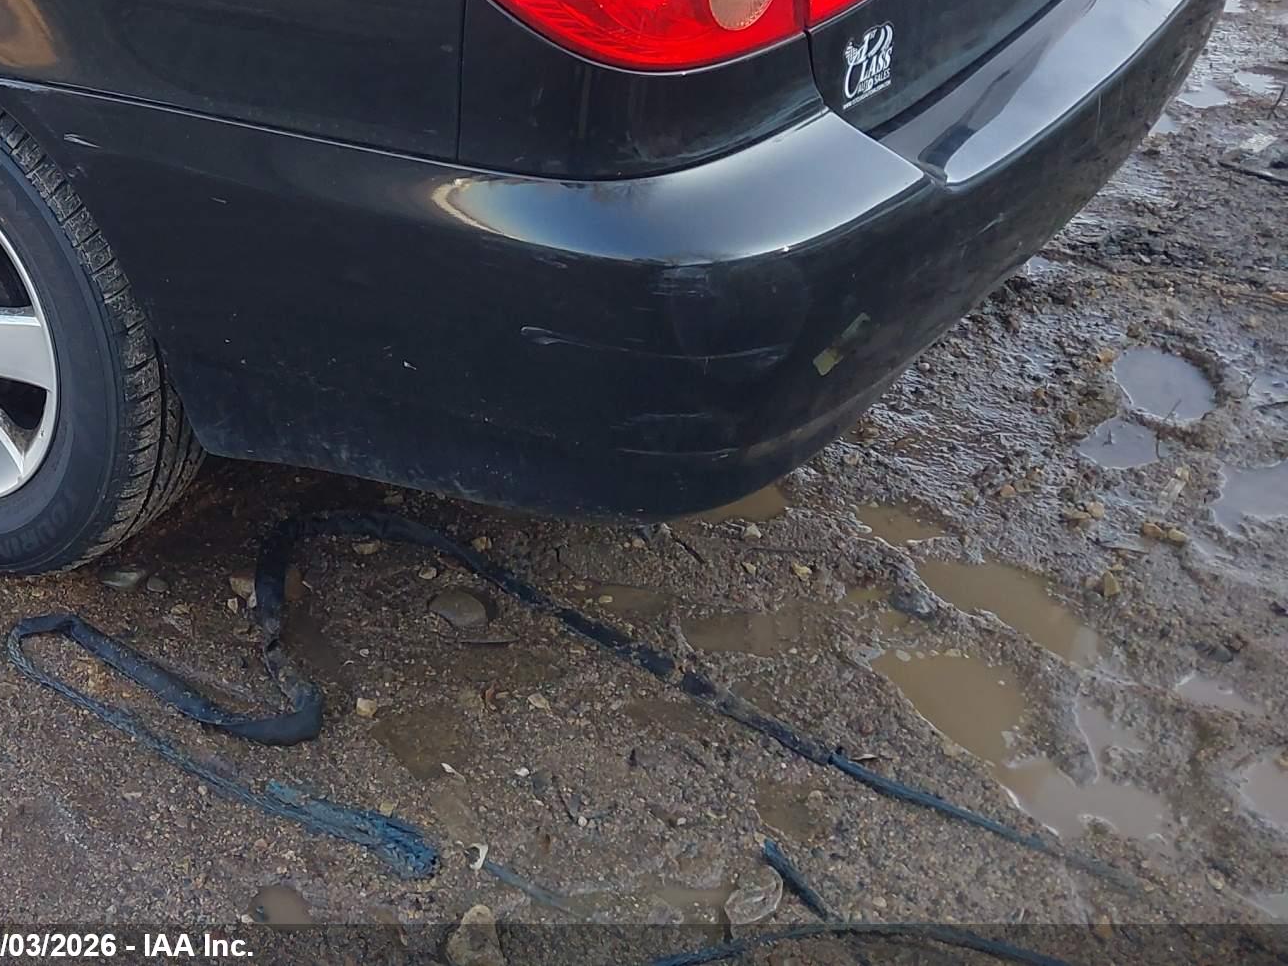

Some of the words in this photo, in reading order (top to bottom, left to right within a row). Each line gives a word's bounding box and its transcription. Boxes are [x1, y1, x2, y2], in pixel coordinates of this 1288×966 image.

[844, 44, 893, 99] CLASS
[857, 77, 873, 94] AUTO
[873, 68, 891, 84] SALES
